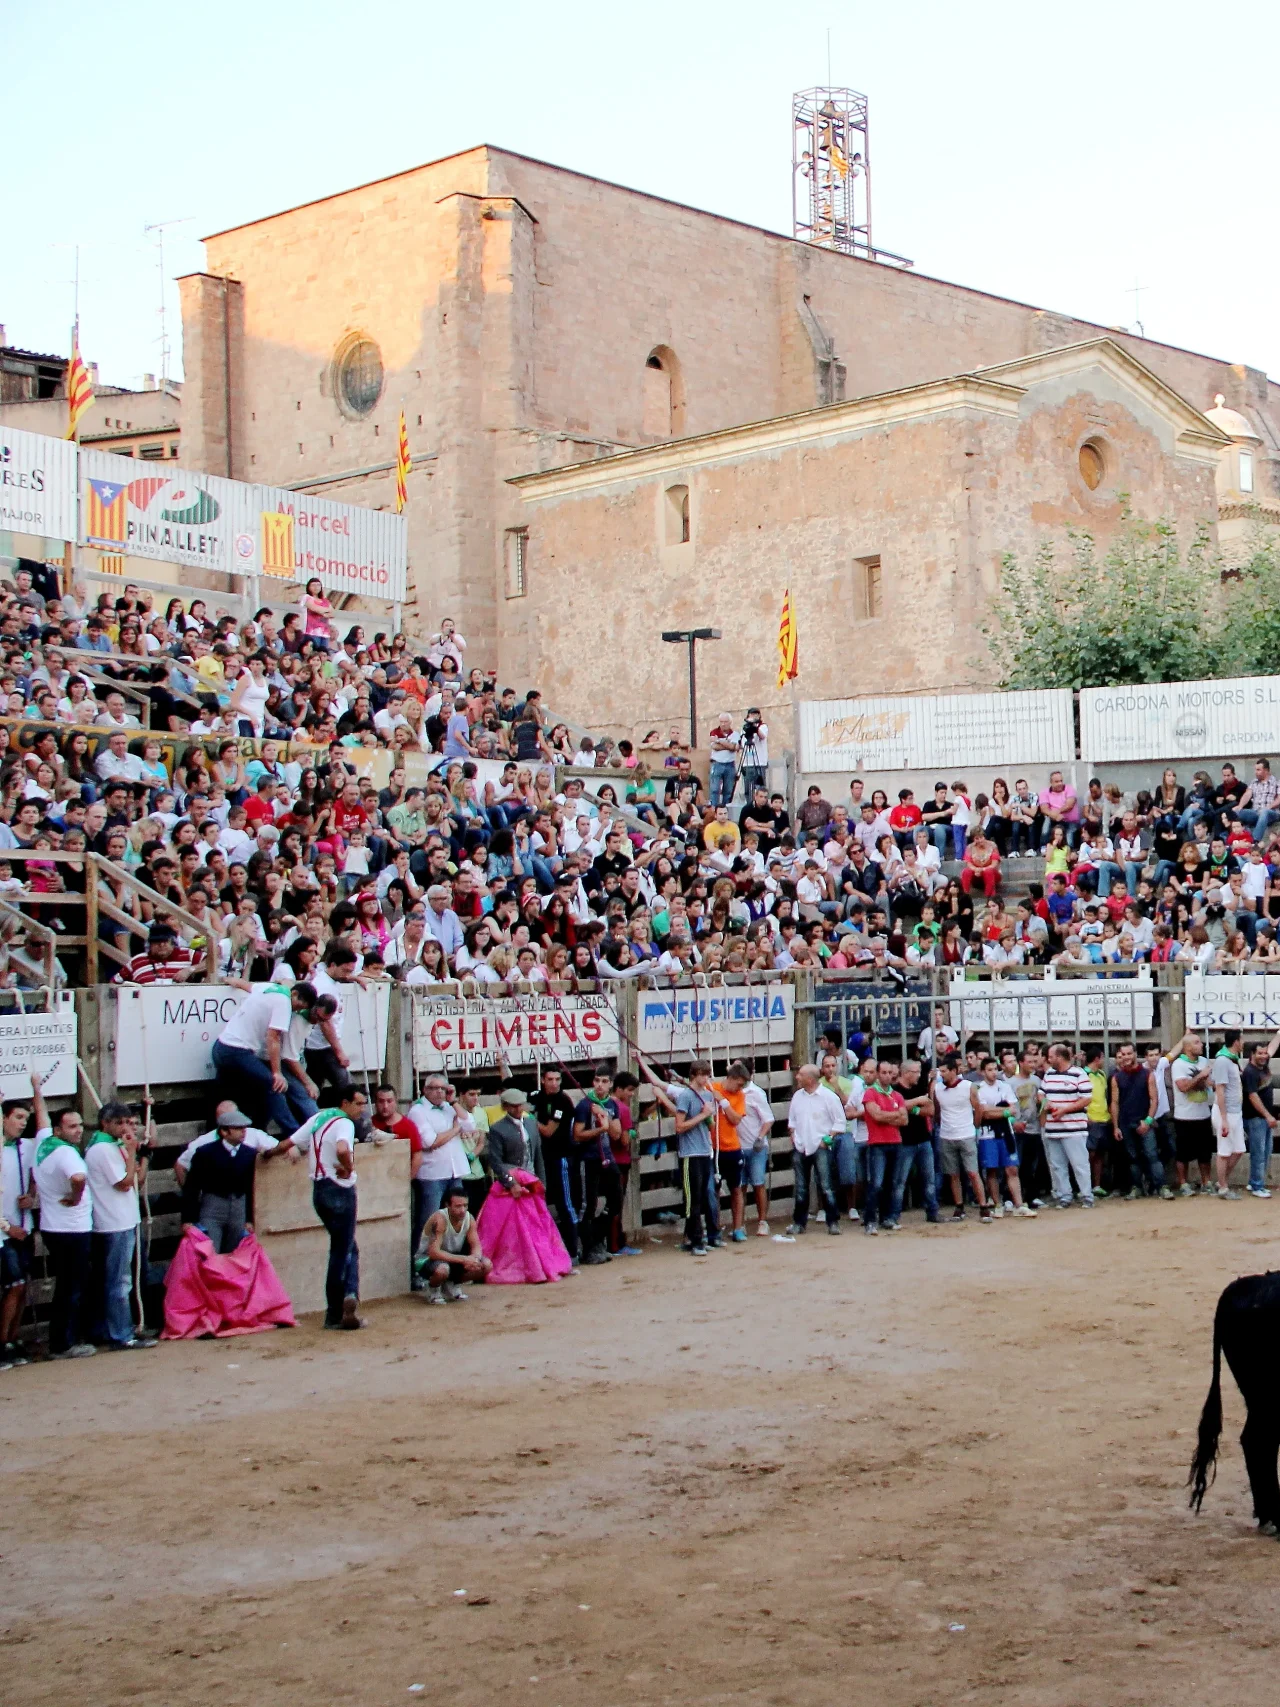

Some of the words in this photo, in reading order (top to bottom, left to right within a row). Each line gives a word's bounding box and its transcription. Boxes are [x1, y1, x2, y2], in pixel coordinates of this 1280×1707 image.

[277, 501, 351, 536] Marcel
[294, 550, 390, 585] utomoció
[1094, 694, 1169, 713] CARDONA
[1178, 690, 1245, 708] MOTORS
[1254, 688, 1280, 704] S.L.
[1175, 727, 1207, 737] NISSAN
[1223, 731, 1275, 744] CARDONA
[1088, 997, 1130, 1005] AGRCOLA
[1193, 991, 1265, 1002] JOIERIA
[423, 1001, 486, 1016] PASTISSRIA
[431, 1011, 601, 1050] CLIMENS
